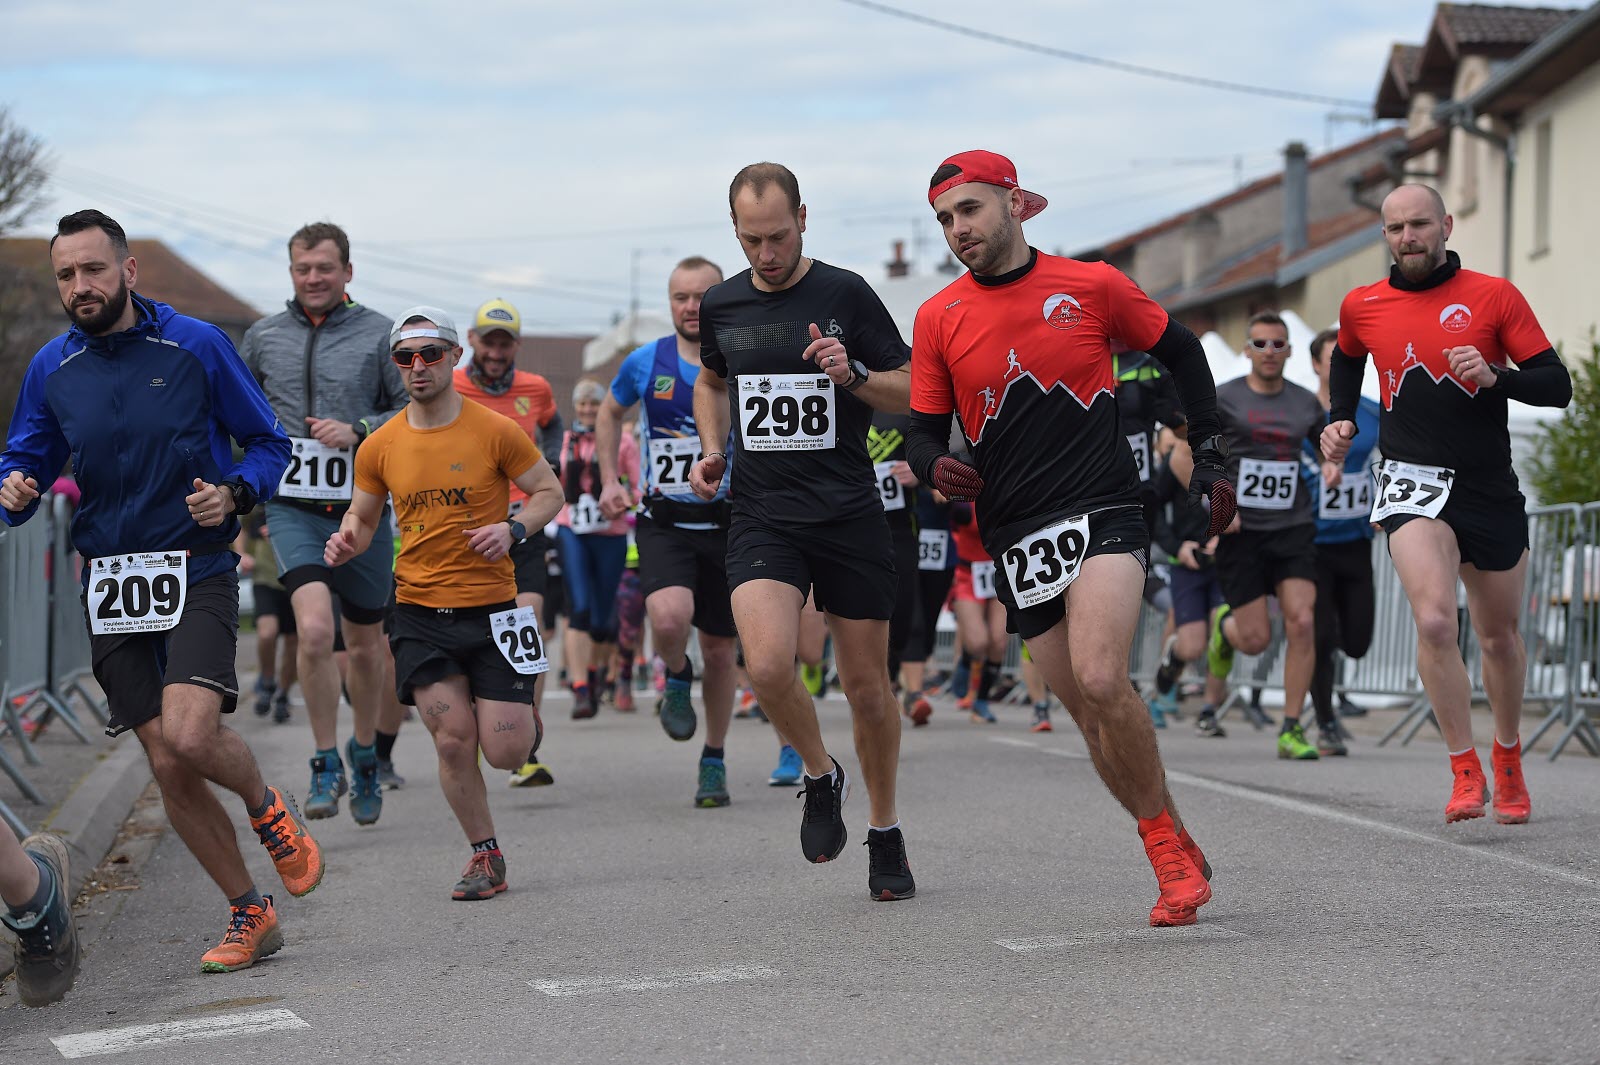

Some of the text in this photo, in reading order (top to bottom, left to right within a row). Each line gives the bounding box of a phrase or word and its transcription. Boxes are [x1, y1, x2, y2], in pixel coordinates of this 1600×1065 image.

[745, 395, 829, 436] 298
[284, 455, 347, 487] 210
[656, 452, 704, 483] 27
[399, 487, 468, 510] MATRYX
[1243, 474, 1293, 499] 295
[1325, 485, 1369, 509] 214
[1006, 529, 1085, 593] 239
[95, 574, 180, 619] 209
[500, 625, 547, 663] 29
